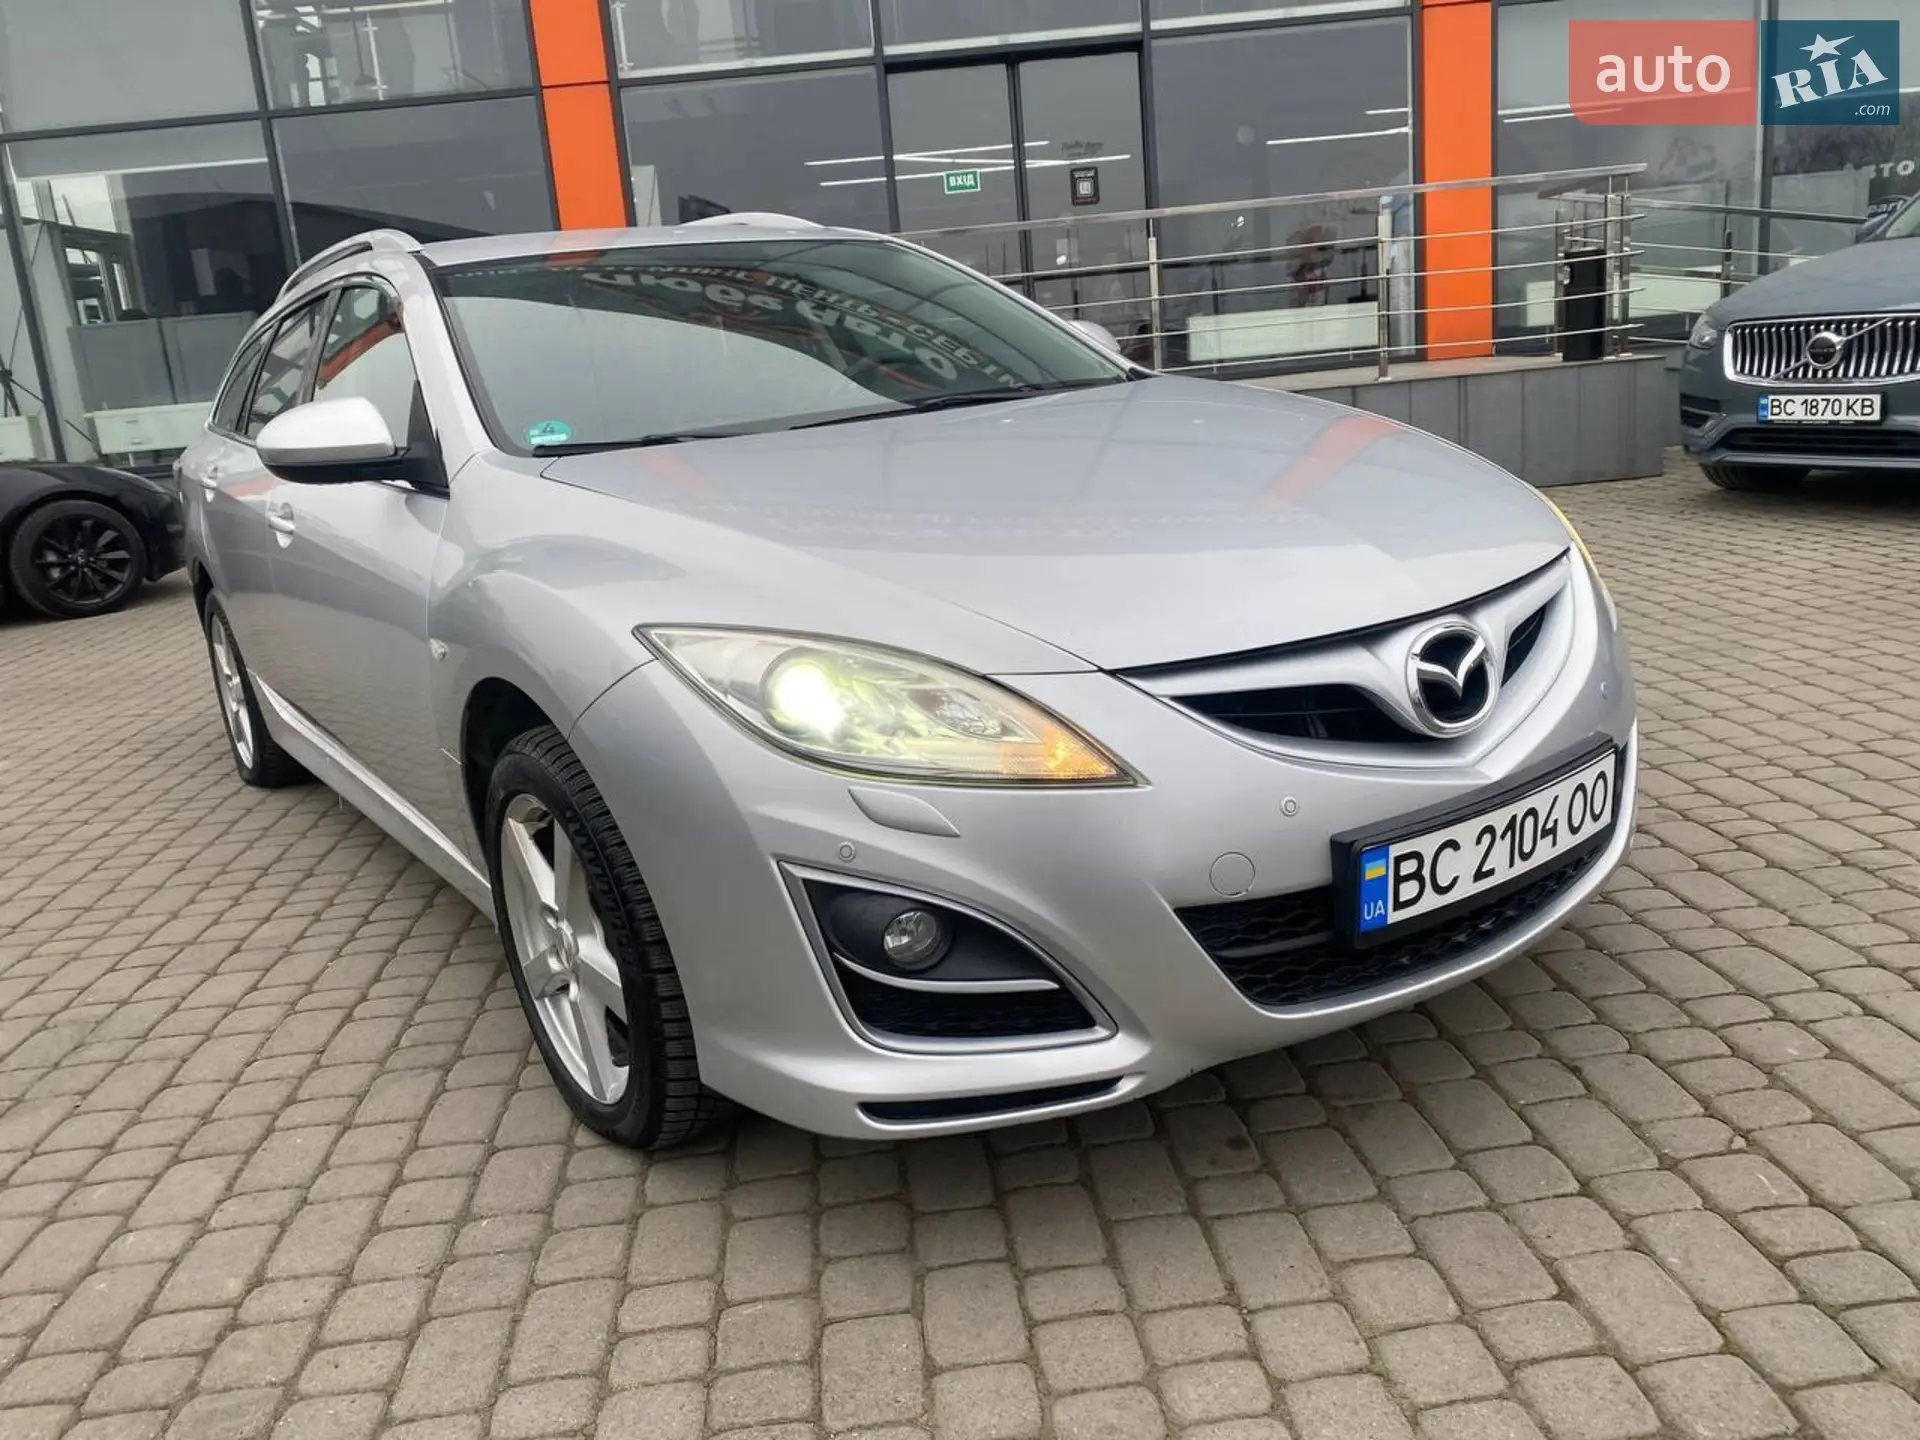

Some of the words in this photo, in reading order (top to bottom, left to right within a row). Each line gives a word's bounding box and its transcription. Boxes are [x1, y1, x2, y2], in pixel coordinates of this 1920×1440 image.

[949, 174, 976, 188] ВХІД
[1770, 398, 1796, 416] BC
[1801, 398, 1842, 416] 1870
[1845, 398, 1875, 416] KB
[1392, 838, 1461, 913] BC
[1473, 794, 1559, 883] 2104
[1364, 899, 1386, 921] UA
